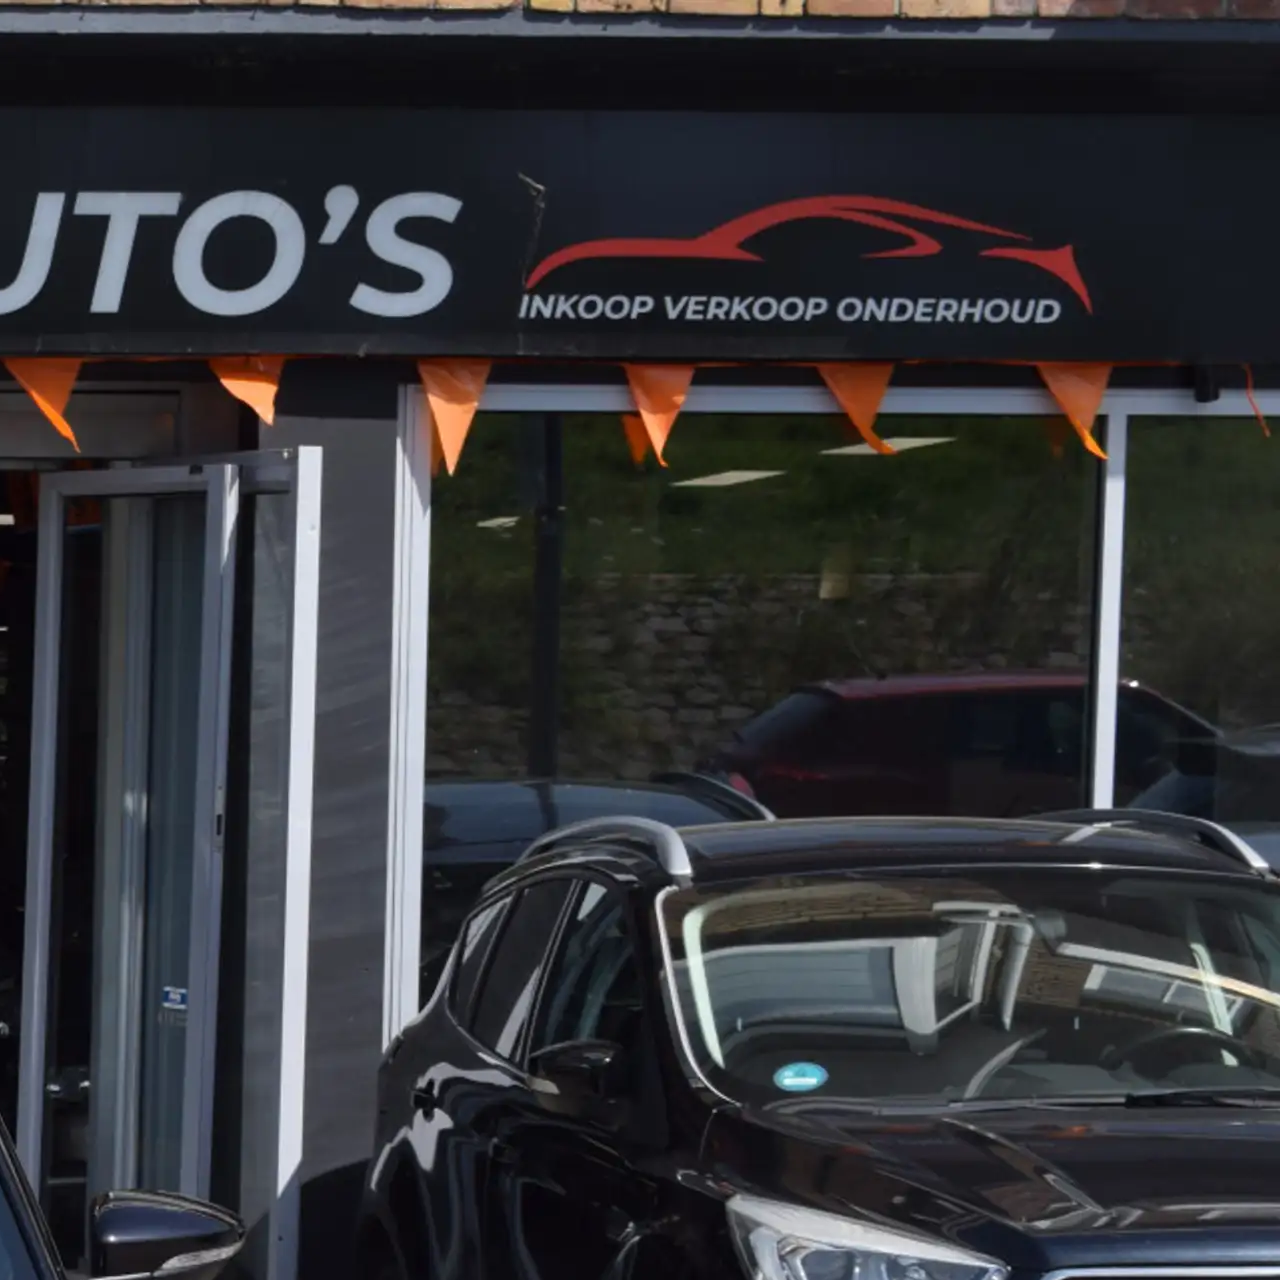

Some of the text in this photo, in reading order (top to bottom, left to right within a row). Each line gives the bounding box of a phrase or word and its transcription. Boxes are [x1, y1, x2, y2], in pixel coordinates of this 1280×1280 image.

[517, 294, 1062, 325] INKOOP VERKOOP ONDERHOUD
